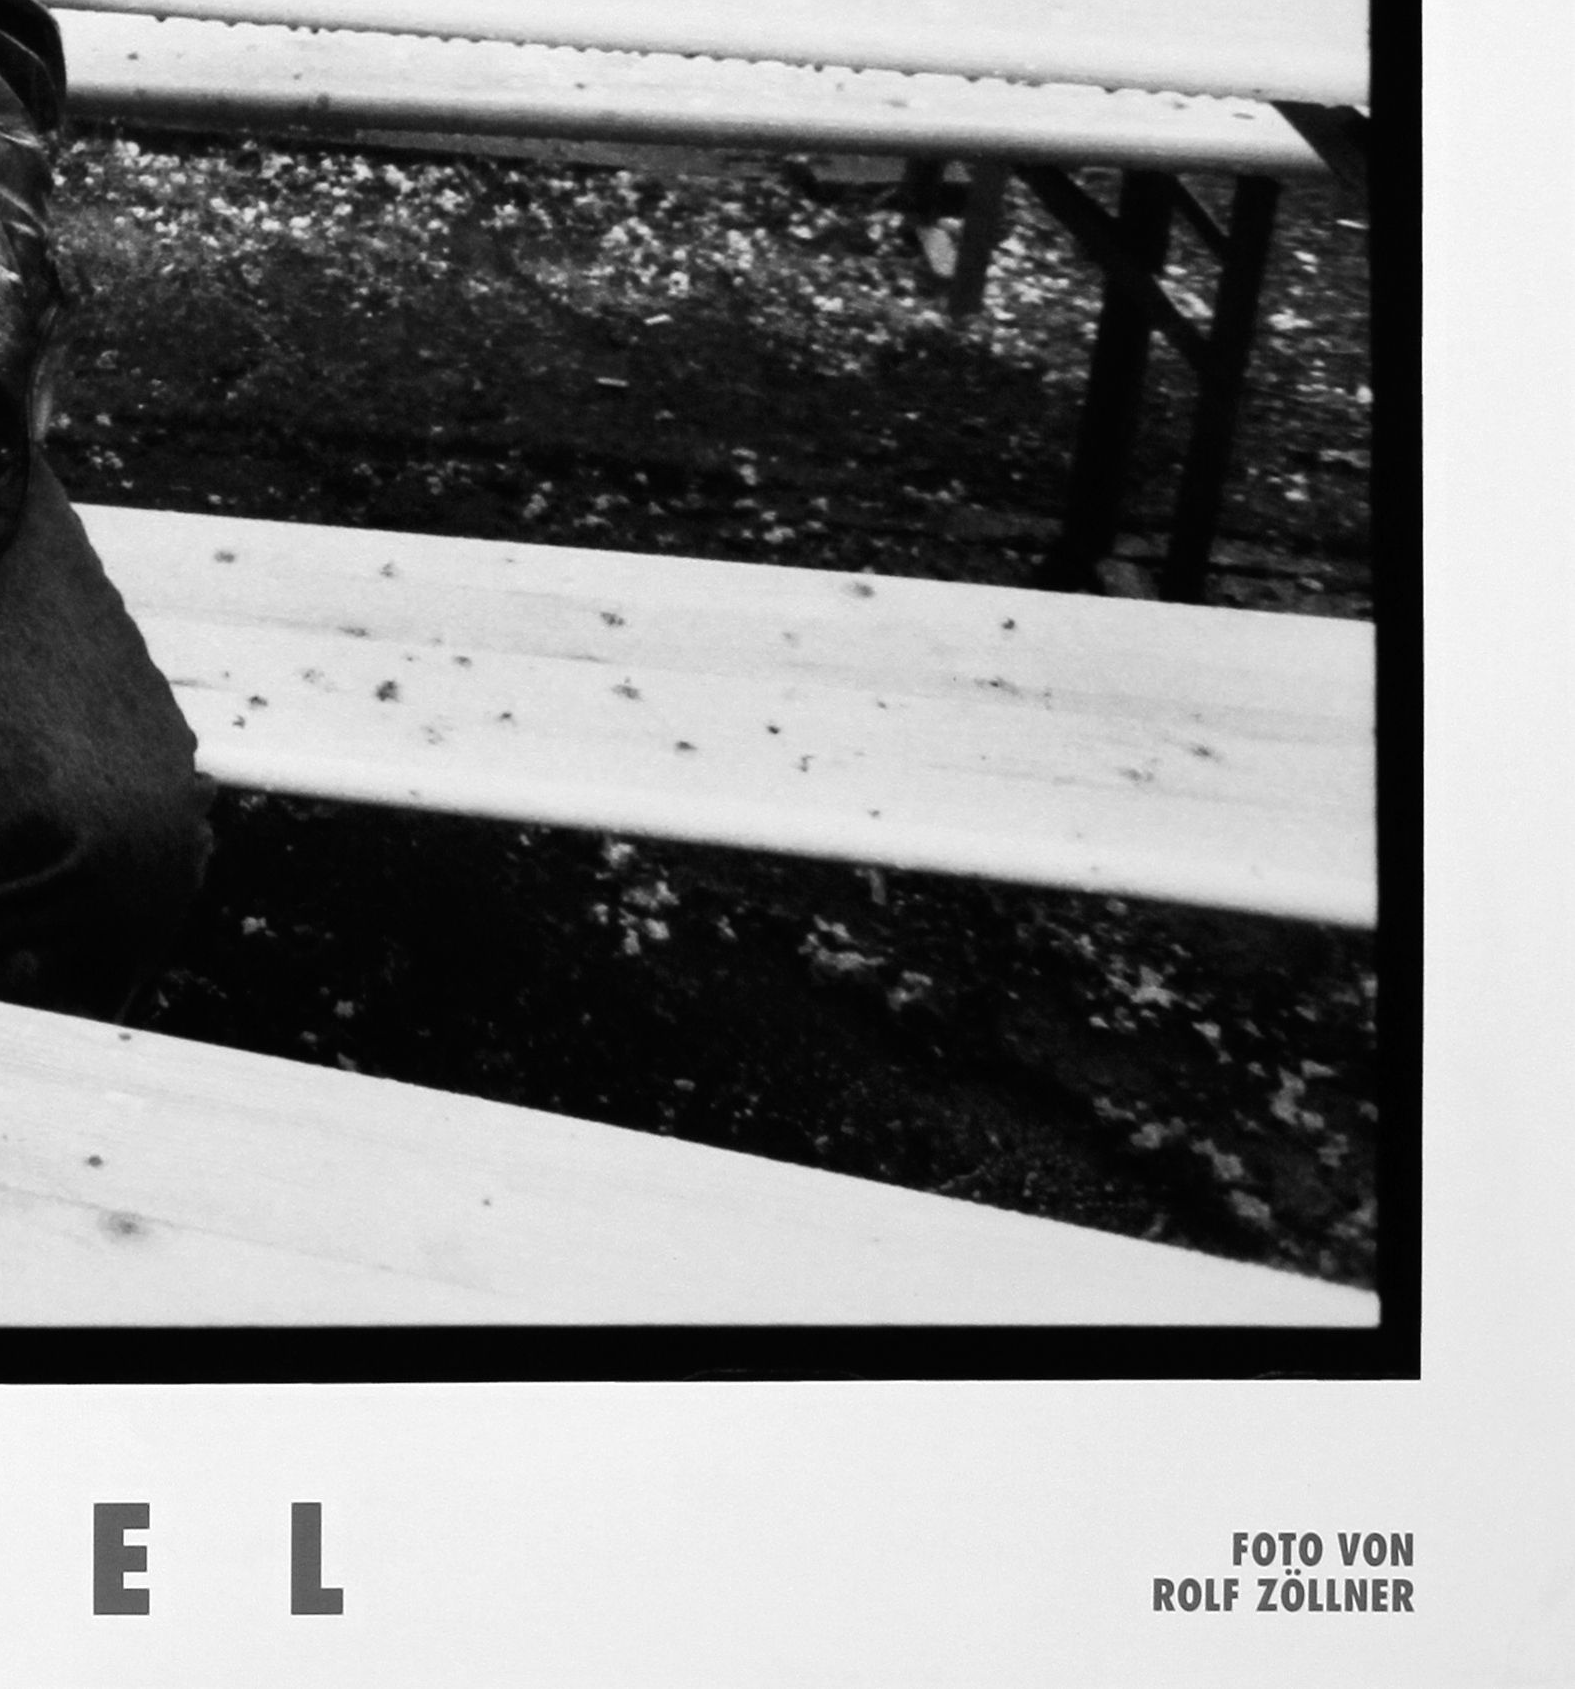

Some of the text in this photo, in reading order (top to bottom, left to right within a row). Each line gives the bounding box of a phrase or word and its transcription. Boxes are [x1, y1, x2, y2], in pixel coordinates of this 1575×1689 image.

[1232, 1532, 1414, 1567] FOTO VON
[1153, 1568, 1414, 1613] ROLF ZÖLLNER
